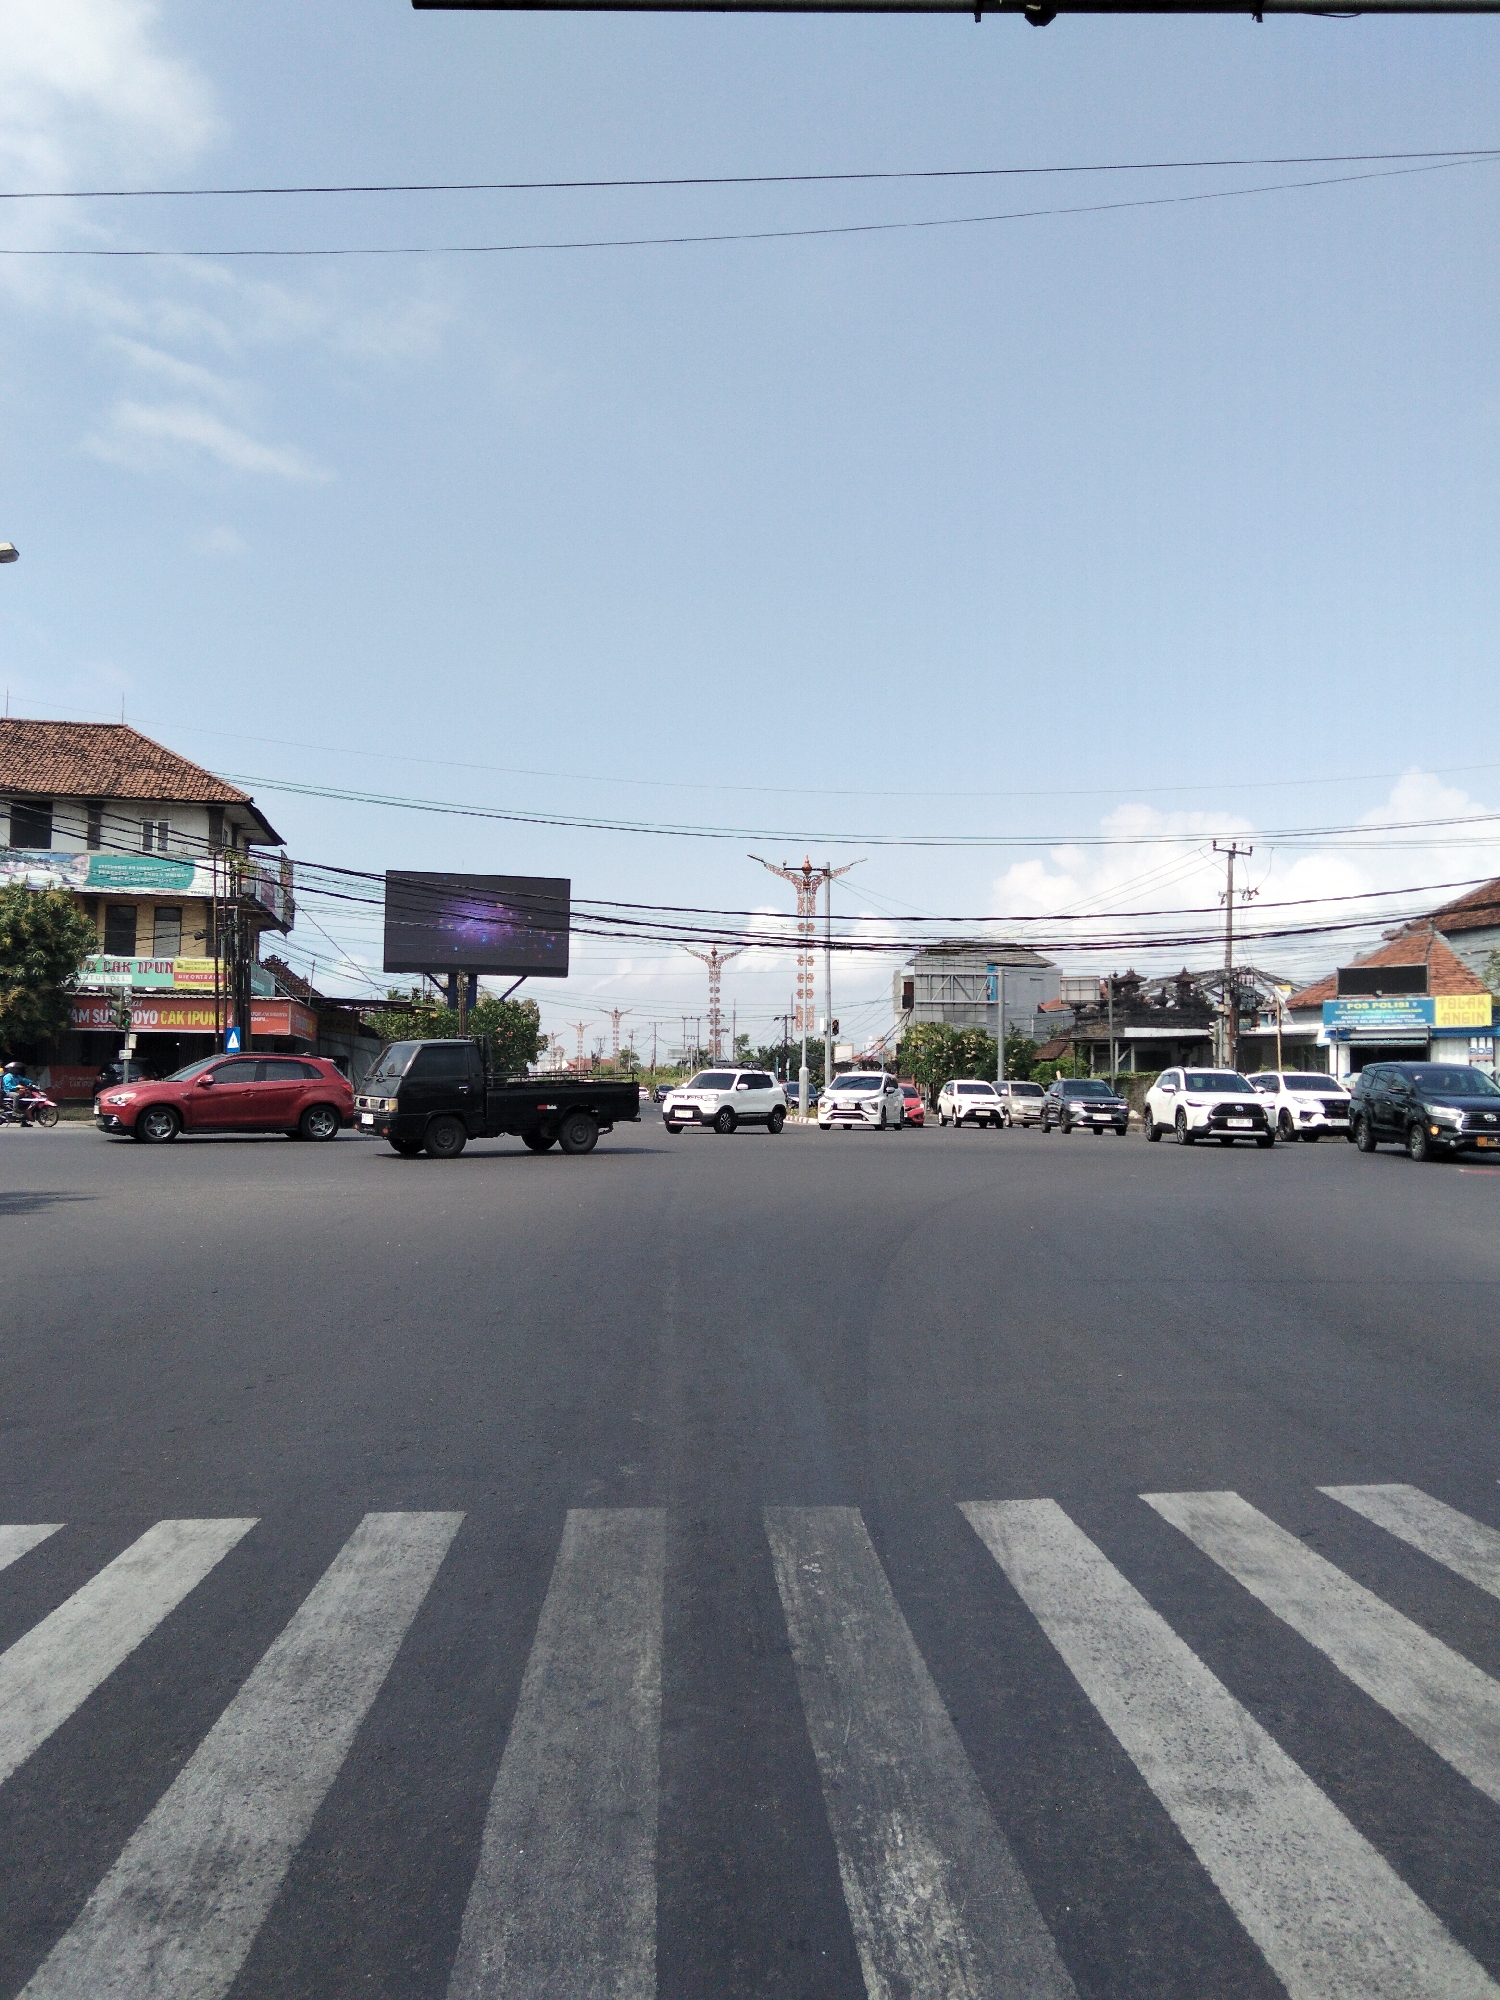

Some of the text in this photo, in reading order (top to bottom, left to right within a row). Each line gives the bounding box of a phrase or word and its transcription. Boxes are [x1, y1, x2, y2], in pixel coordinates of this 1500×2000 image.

[102, 960, 131, 973] CAK
[1372, 1001, 1409, 1009] POLISI
[1438, 996, 1487, 1010] TOLAK
[160, 1010, 185, 1025] CAK
[1441, 1011, 1486, 1024] ANGIN
[1469, 1047, 1493, 1055] POS
